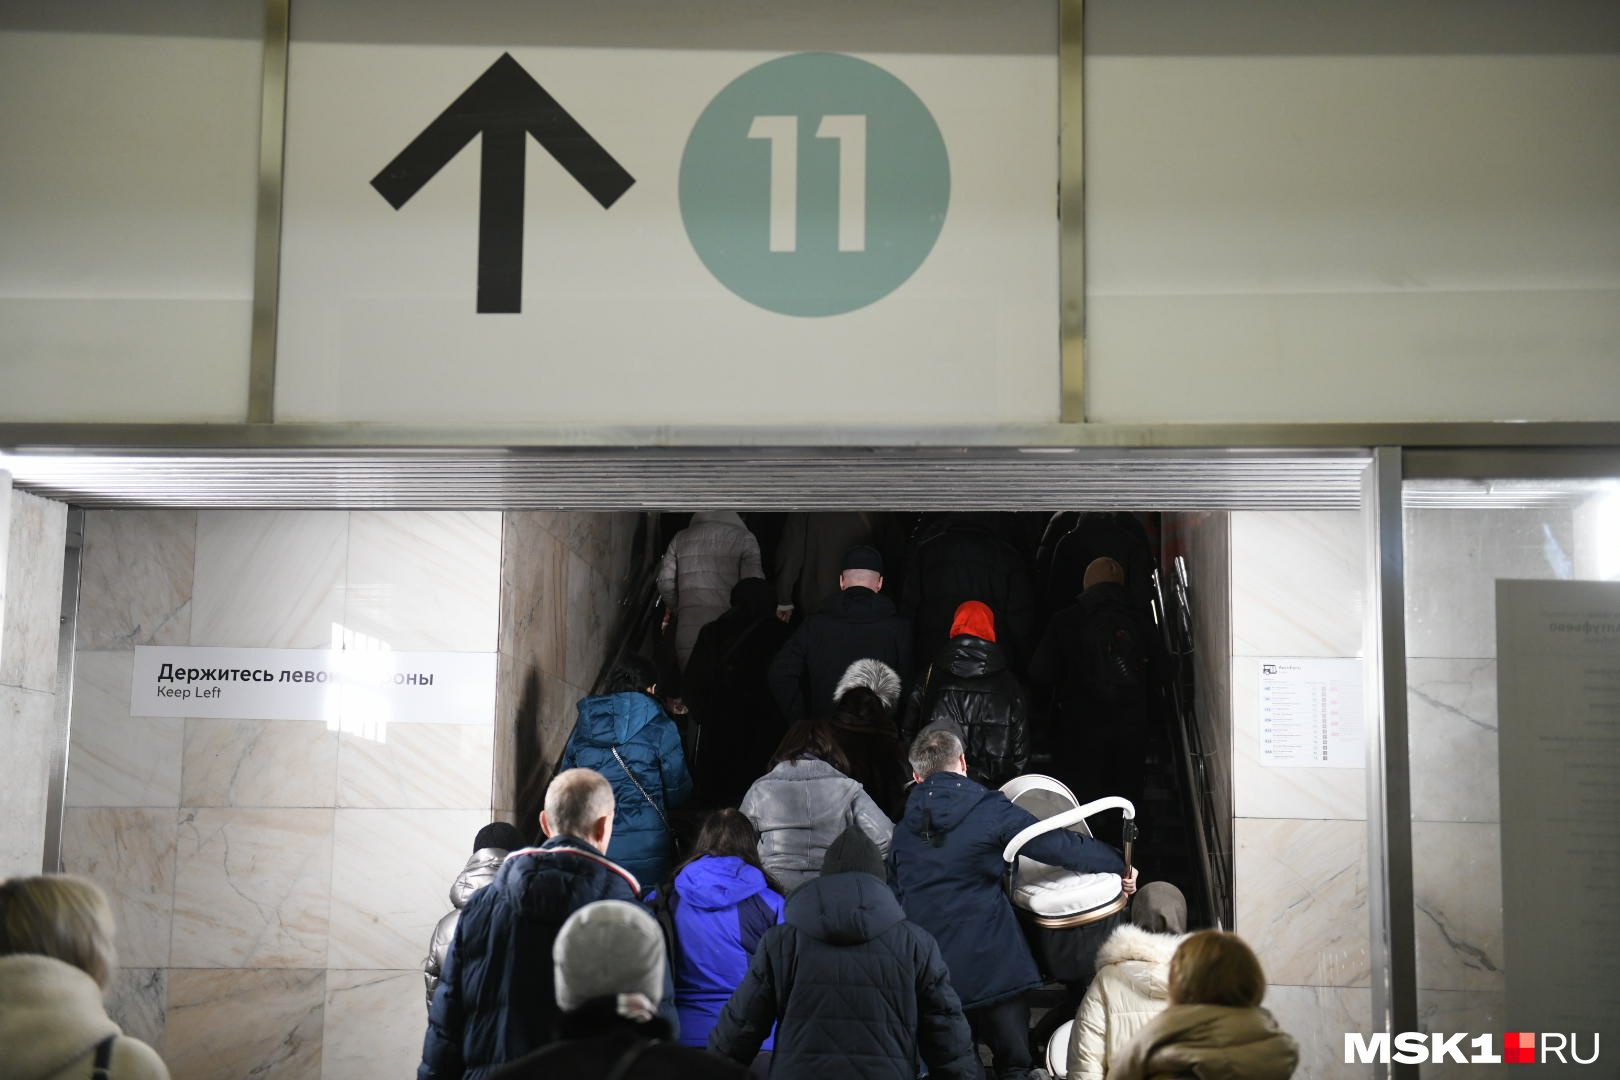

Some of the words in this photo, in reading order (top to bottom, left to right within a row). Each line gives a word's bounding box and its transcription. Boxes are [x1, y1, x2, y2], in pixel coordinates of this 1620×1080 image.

[746, 114, 867, 252] 11
[157, 663, 274, 684] Держитесь
[157, 685, 191, 700] Keep
[195, 686, 222, 698] Left
